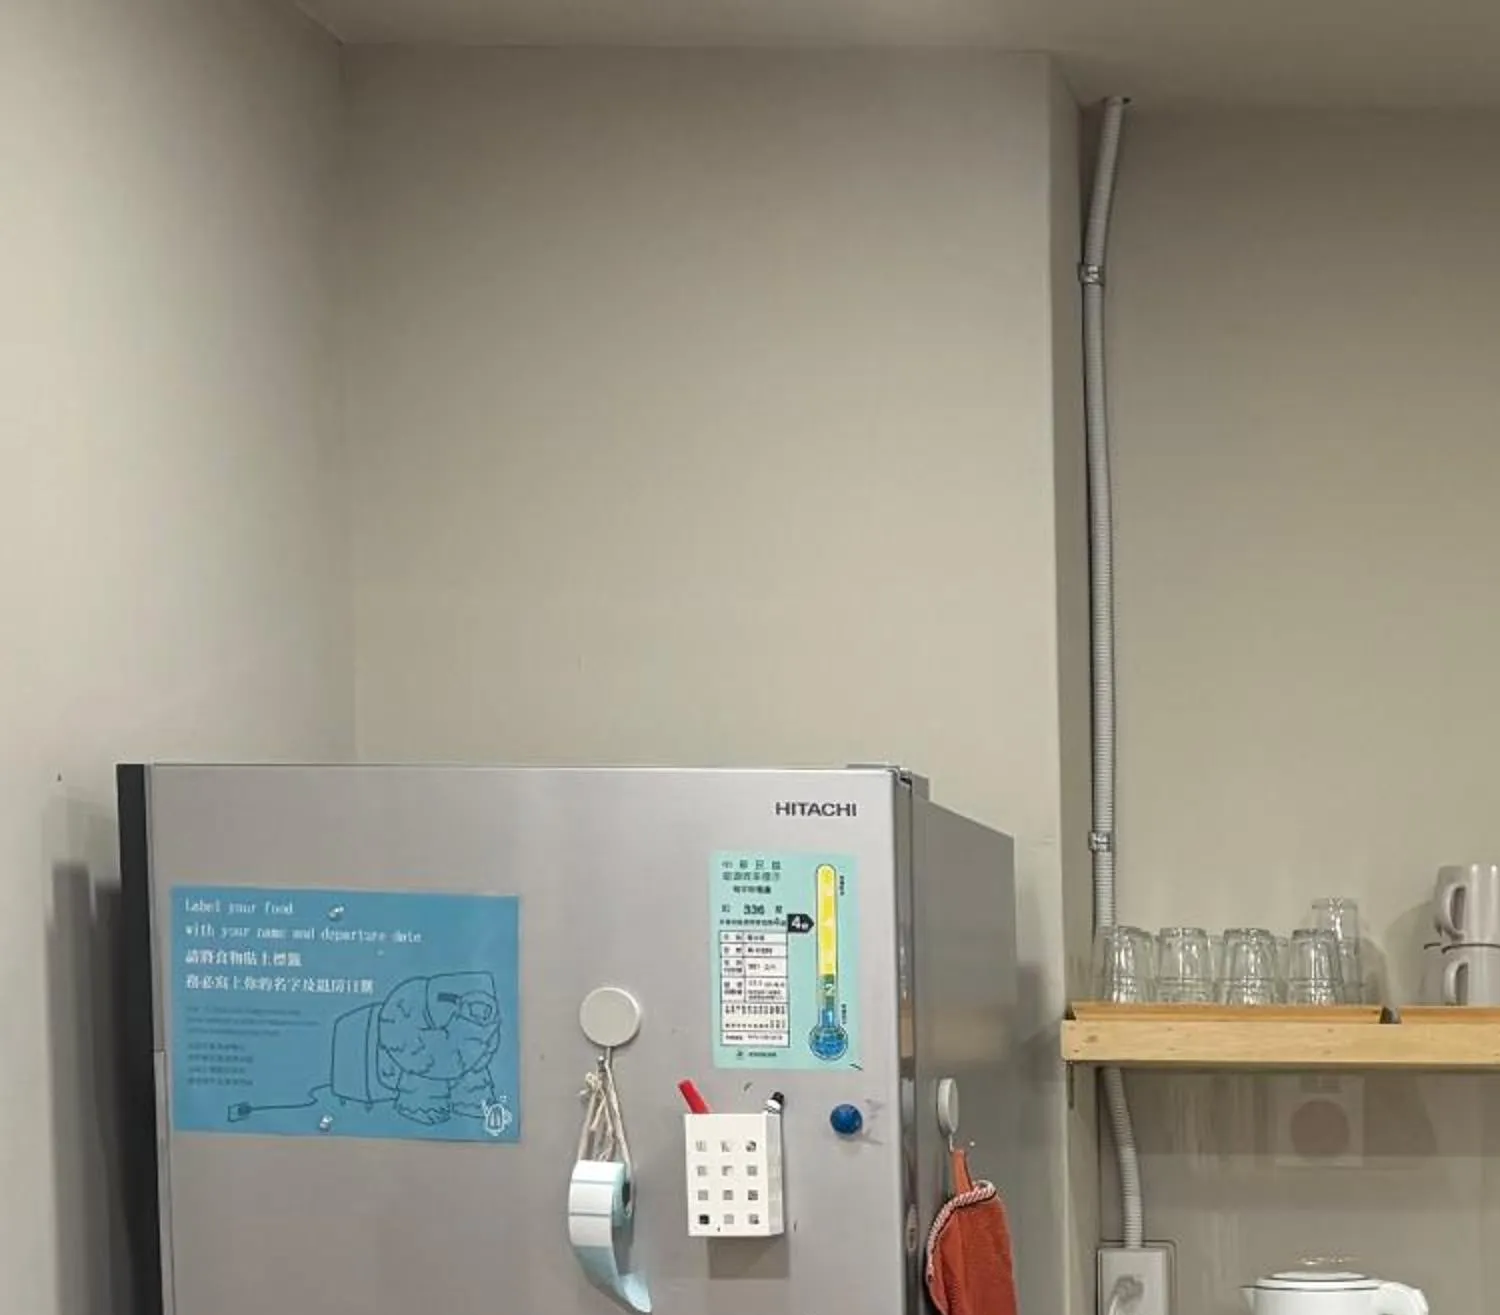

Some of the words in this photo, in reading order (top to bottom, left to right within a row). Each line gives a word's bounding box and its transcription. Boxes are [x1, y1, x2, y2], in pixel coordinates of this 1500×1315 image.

[775, 801, 857, 817] HITACHI
[185, 897, 220, 914] Label
[228, 901, 256, 916] your
[265, 900, 293, 915] food
[185, 921, 215, 937] with
[221, 926, 251, 939] your
[257, 927, 285, 939] name
[291, 926, 315, 940] and
